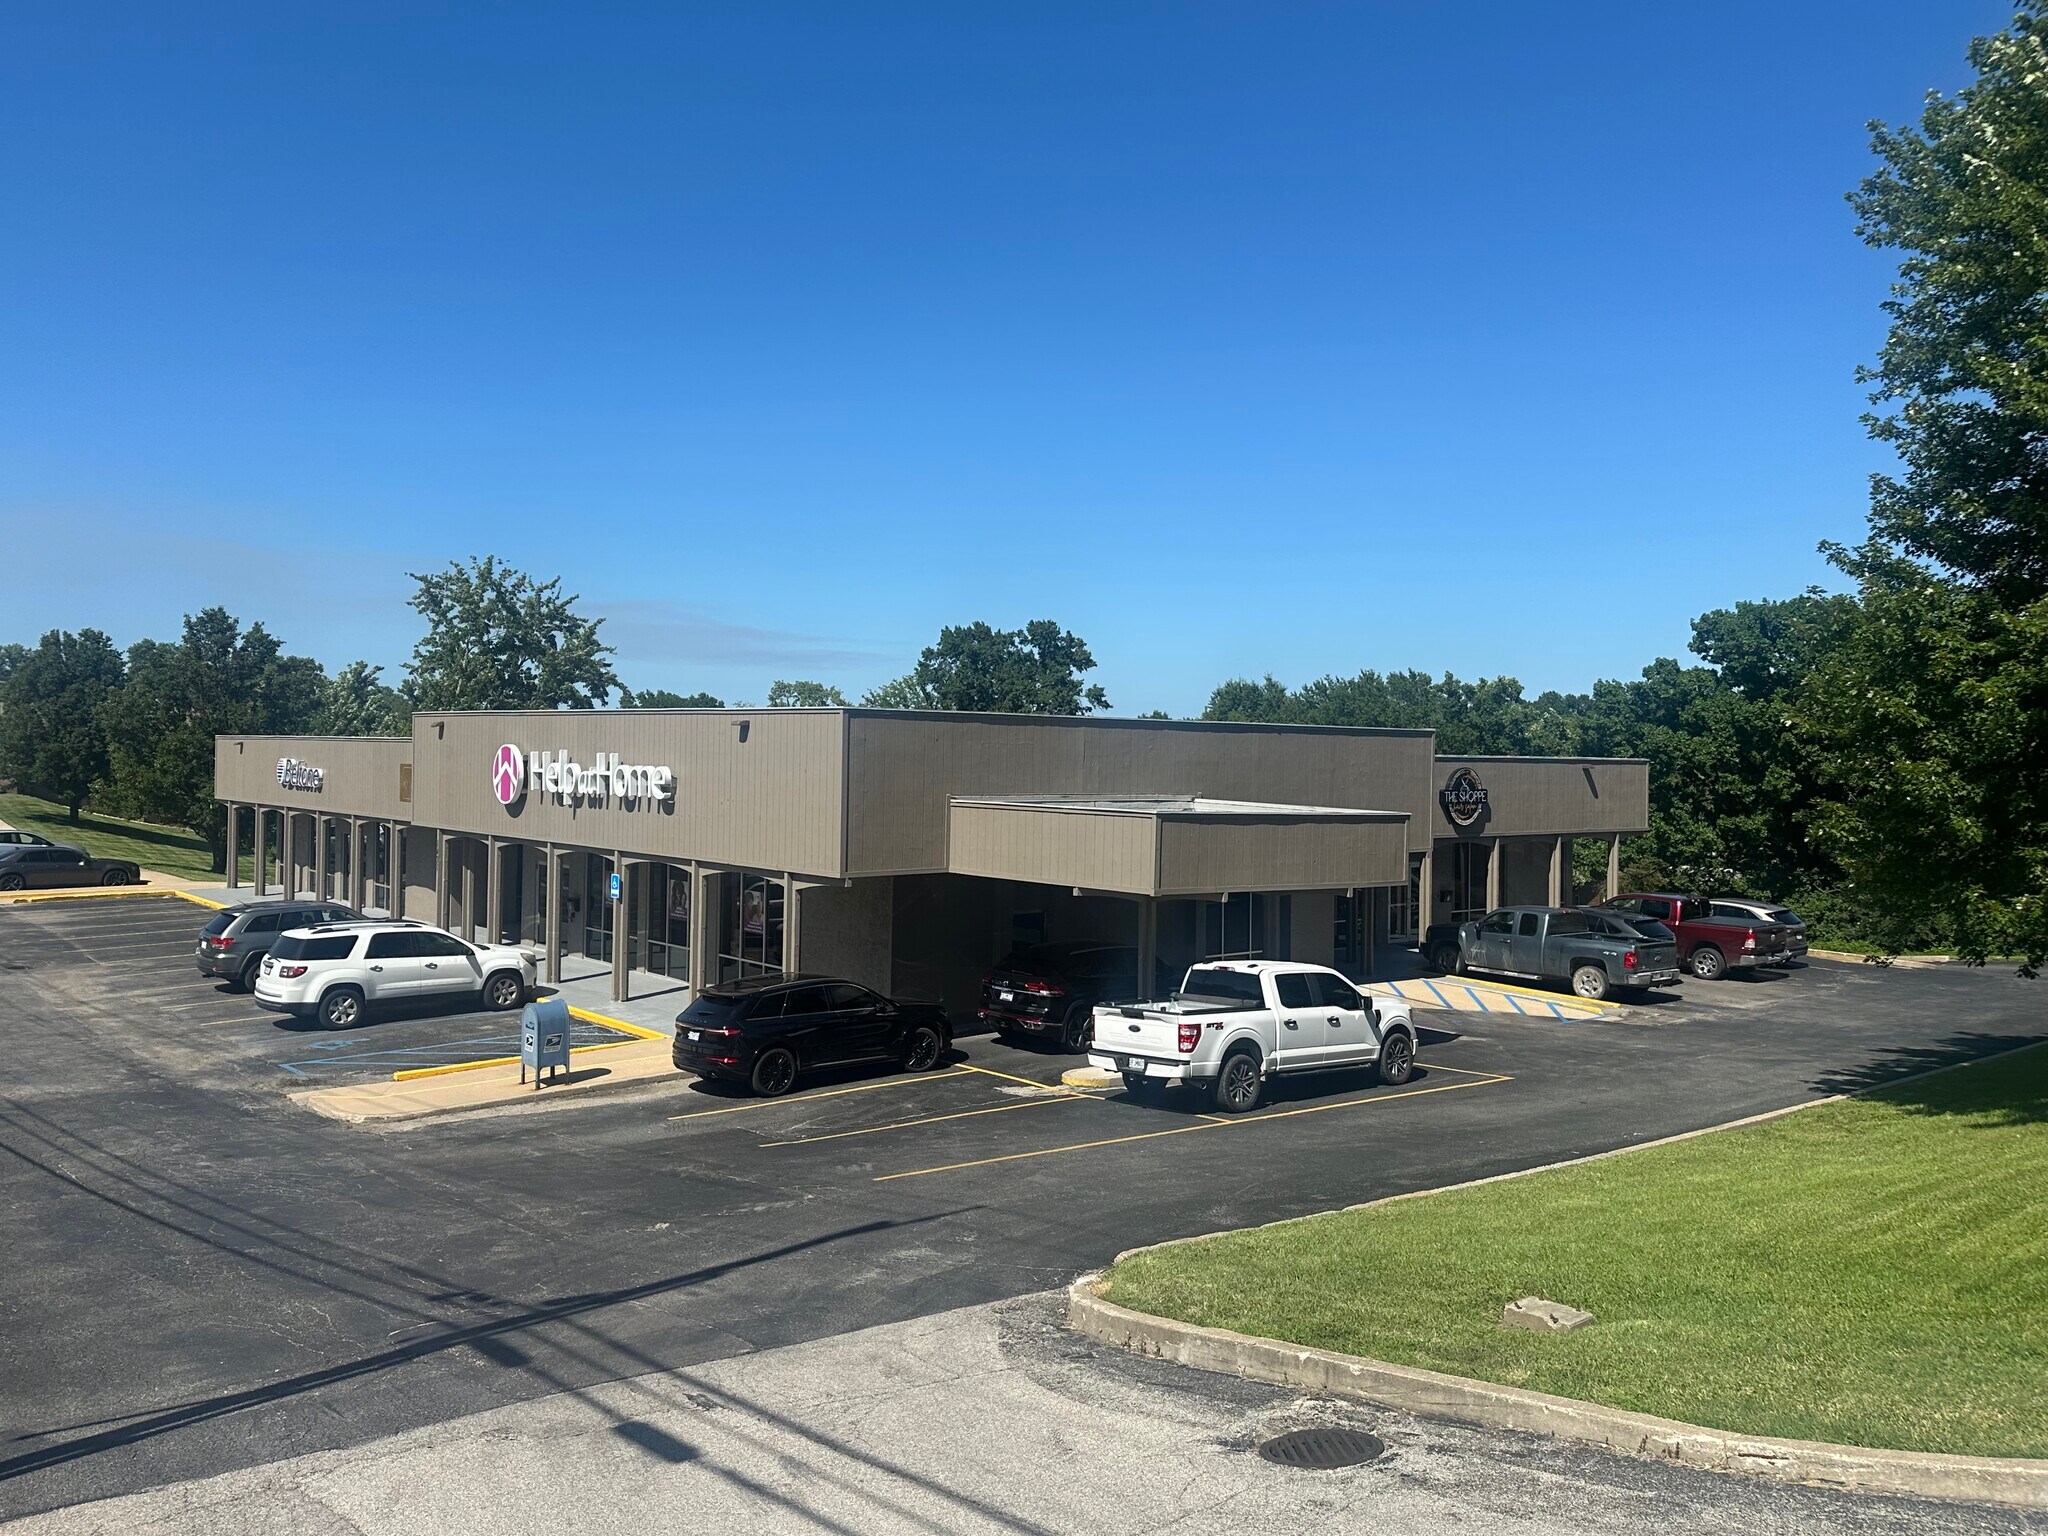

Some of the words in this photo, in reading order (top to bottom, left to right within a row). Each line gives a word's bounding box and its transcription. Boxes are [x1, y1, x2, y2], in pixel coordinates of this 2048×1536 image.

[530, 749, 582, 805] Help
[578, 767, 599, 794] at
[596, 753, 672, 800] Home
[1444, 790, 1458, 803] THE
[1459, 790, 1487, 803] SHOPPE
